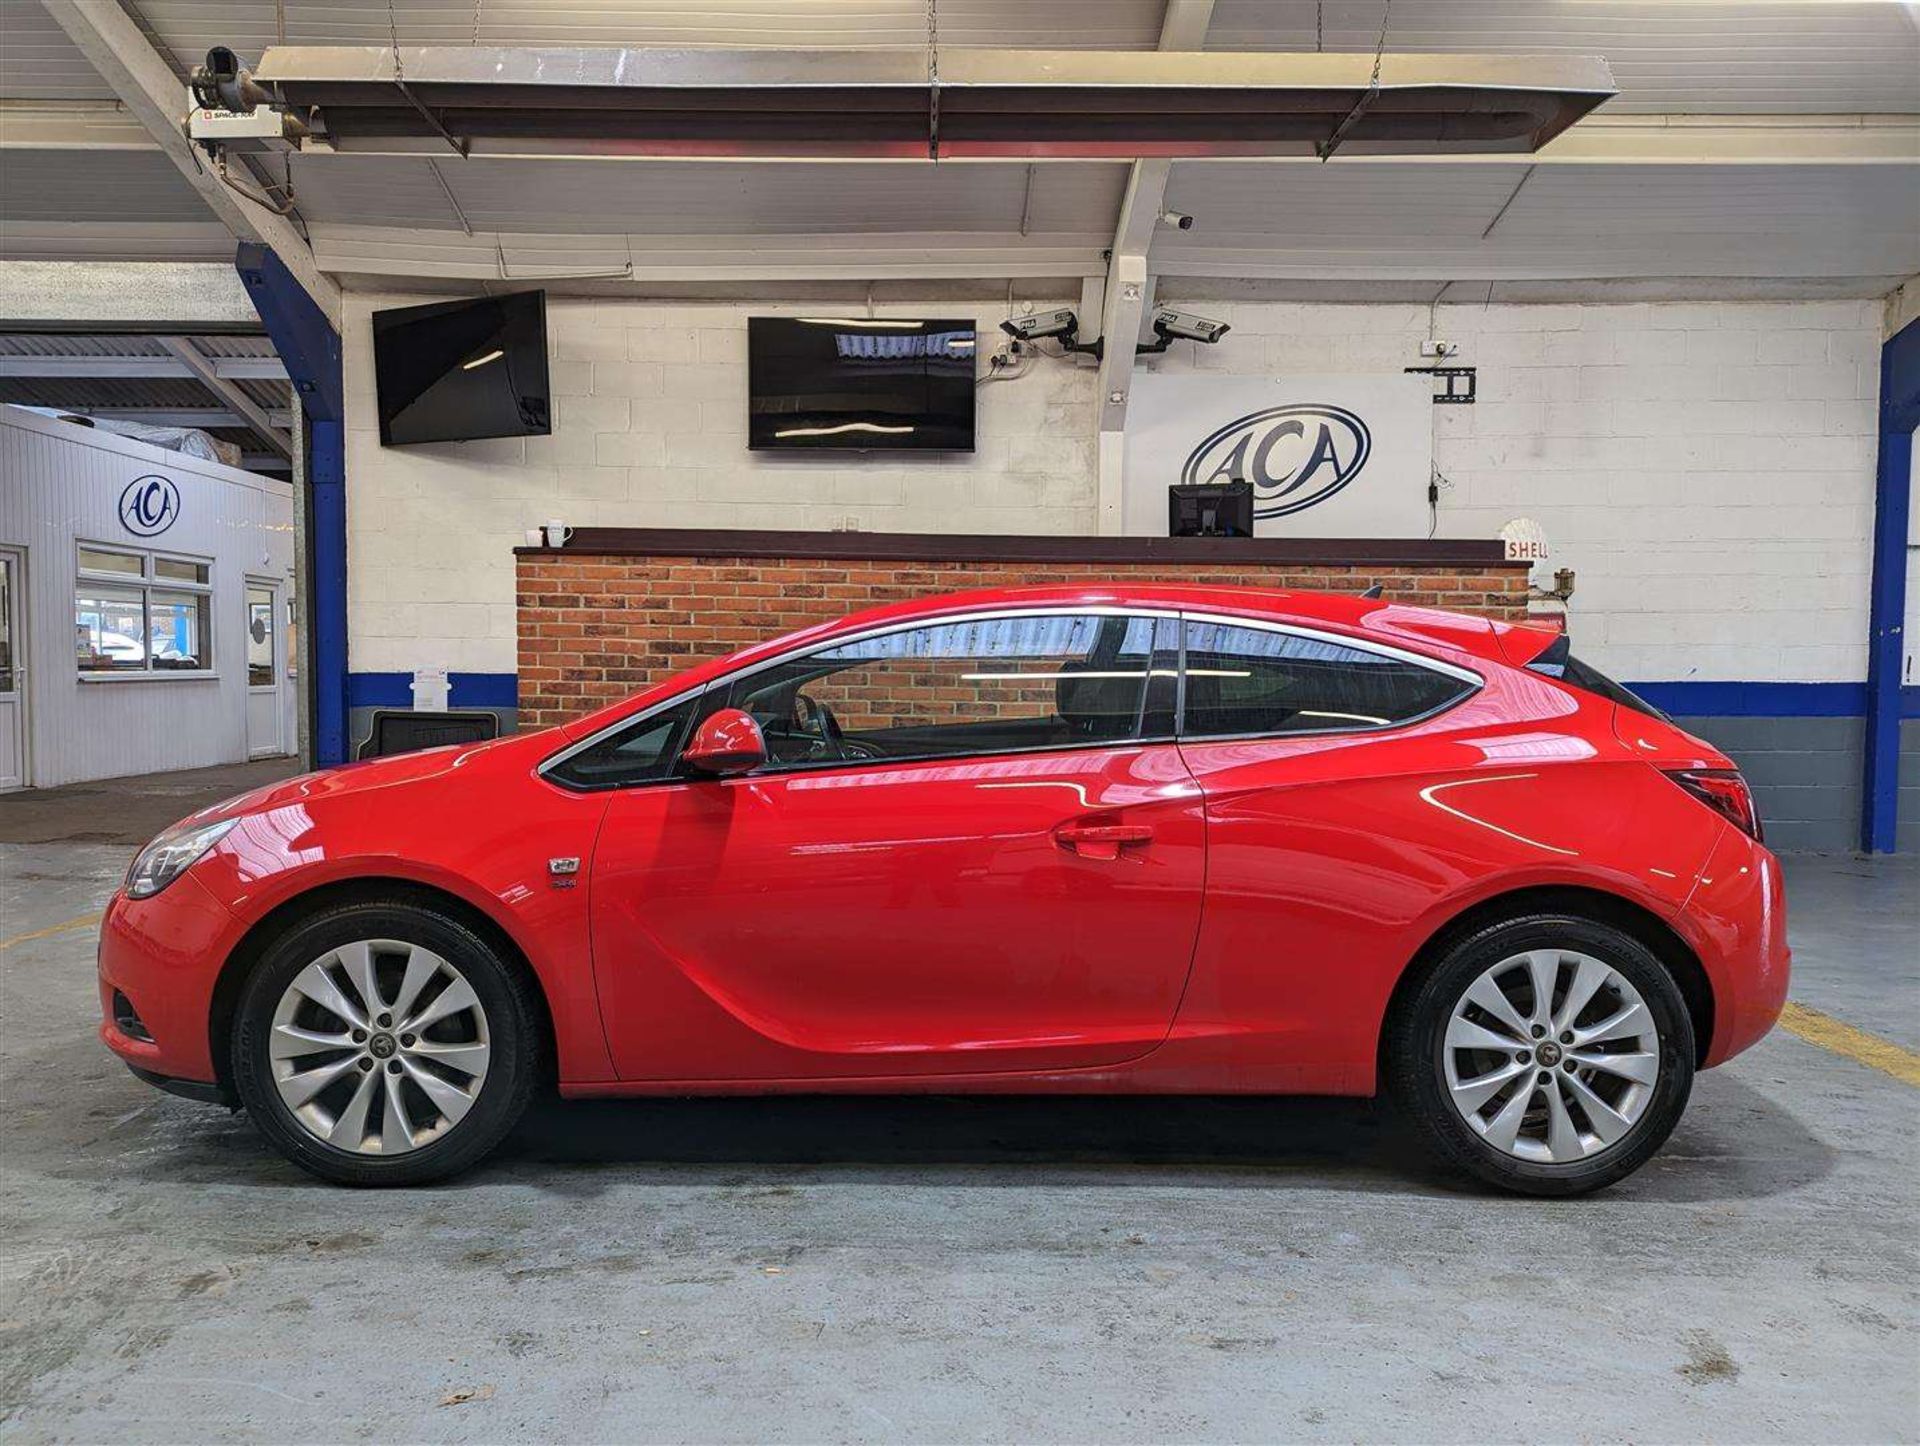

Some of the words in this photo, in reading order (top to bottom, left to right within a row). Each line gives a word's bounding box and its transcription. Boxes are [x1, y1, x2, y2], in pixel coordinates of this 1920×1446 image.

[1206, 419, 1344, 500] ACA
[124, 481, 174, 528] ACA
[1508, 542, 1548, 559] SHELL
